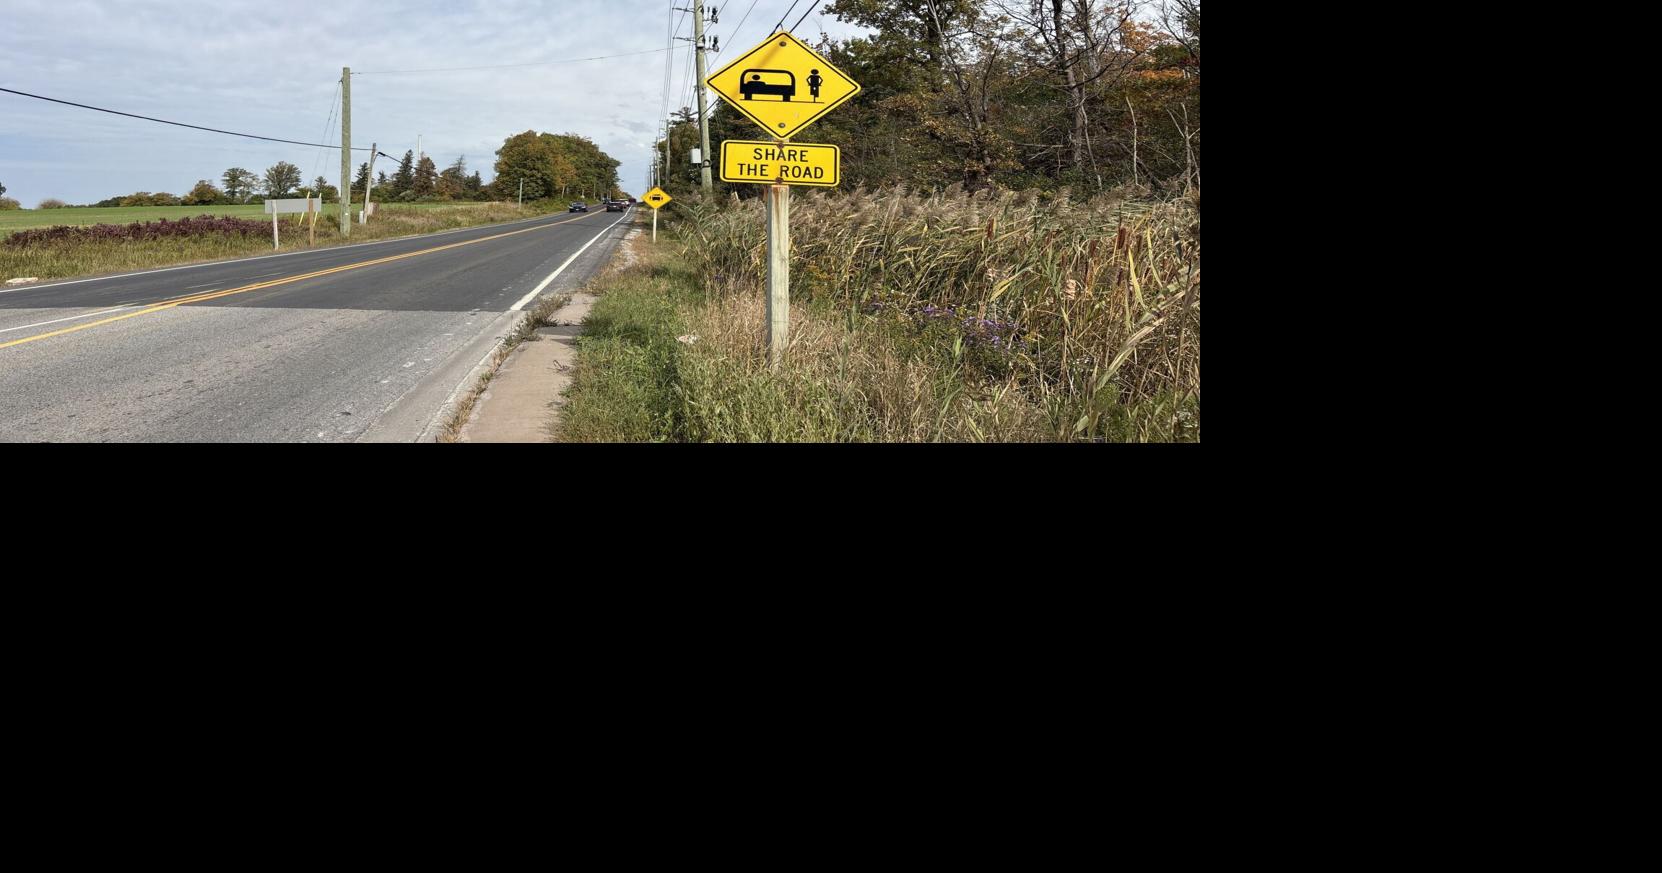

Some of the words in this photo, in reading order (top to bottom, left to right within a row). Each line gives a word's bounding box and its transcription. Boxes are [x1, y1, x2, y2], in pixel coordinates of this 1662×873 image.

[753, 148, 809, 162] SHARE
[737, 163, 769, 176] THE
[780, 165, 824, 179] ROAD
